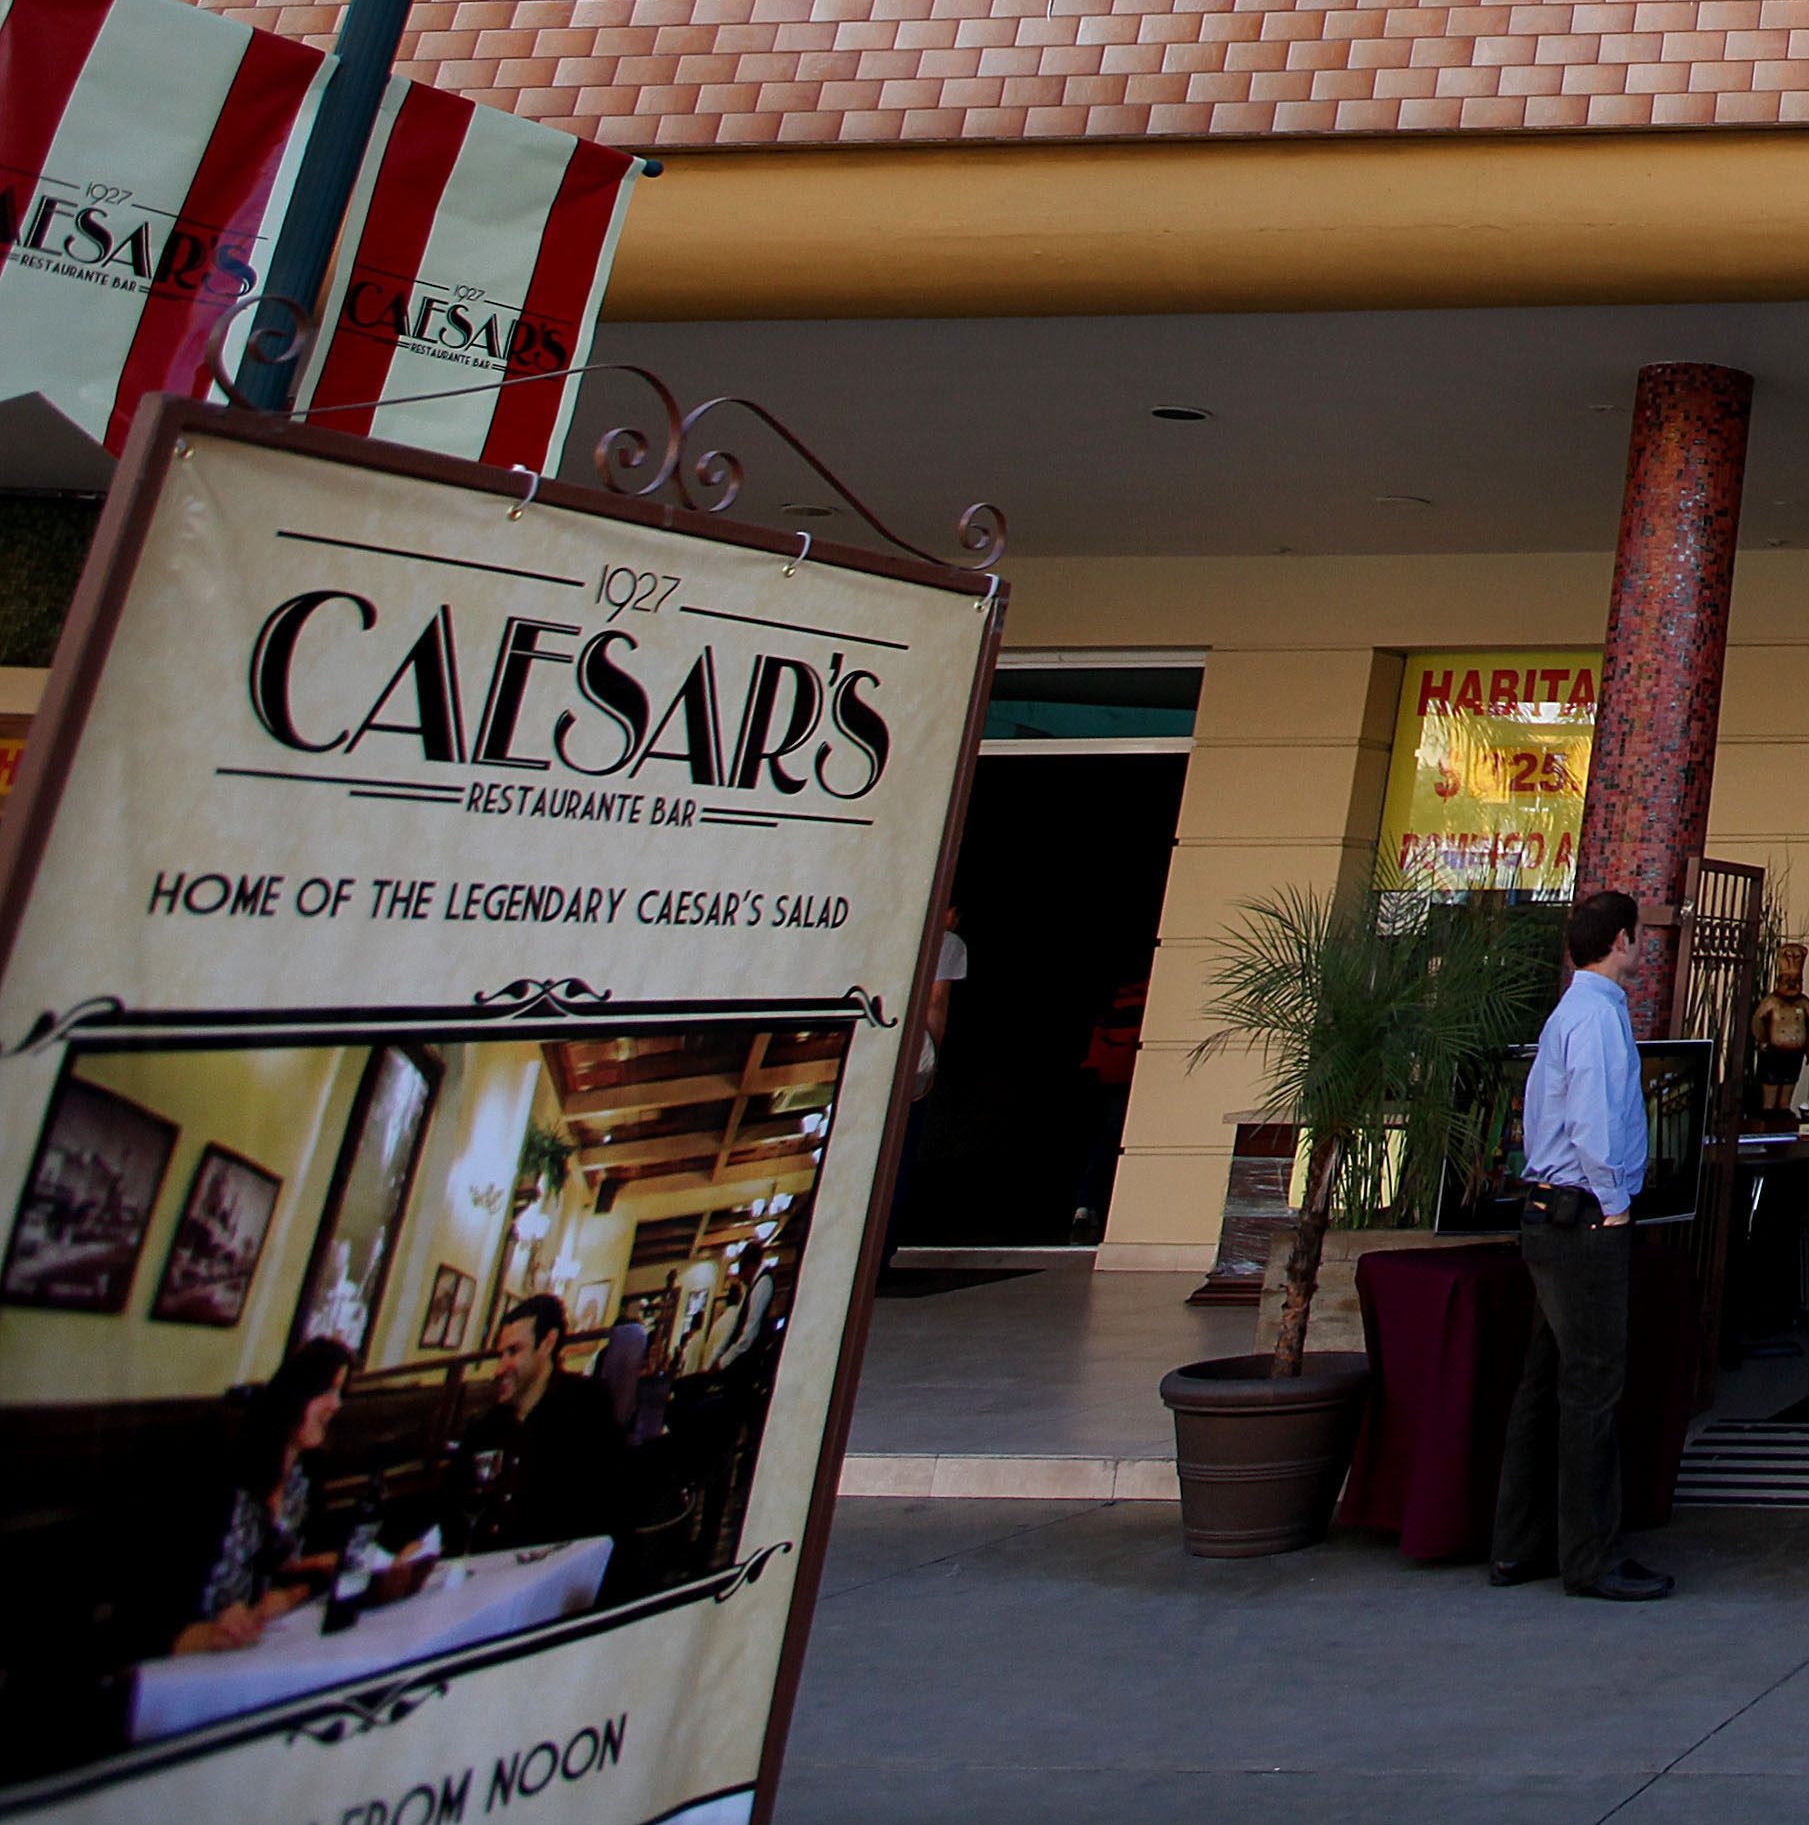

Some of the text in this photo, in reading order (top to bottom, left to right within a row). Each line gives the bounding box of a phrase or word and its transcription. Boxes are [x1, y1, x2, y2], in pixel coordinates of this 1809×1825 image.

[85, 180, 133, 206] 1927
[20, 252, 137, 293] RESTAURANTE BAR
[453, 284, 486, 303] 1927
[346, 280, 568, 372] CAESAR'S
[410, 342, 491, 370] RESTAURANTE BAR
[594, 563, 683, 623] 1927
[248, 589, 892, 801] CAESAR'S
[466, 782, 698, 828] RESTAURANTE BAR
[147, 871, 851, 930] HOME OF THE LEGENDARY CAESAR'S SALAD
[485, 1711, 629, 1815] NOON
